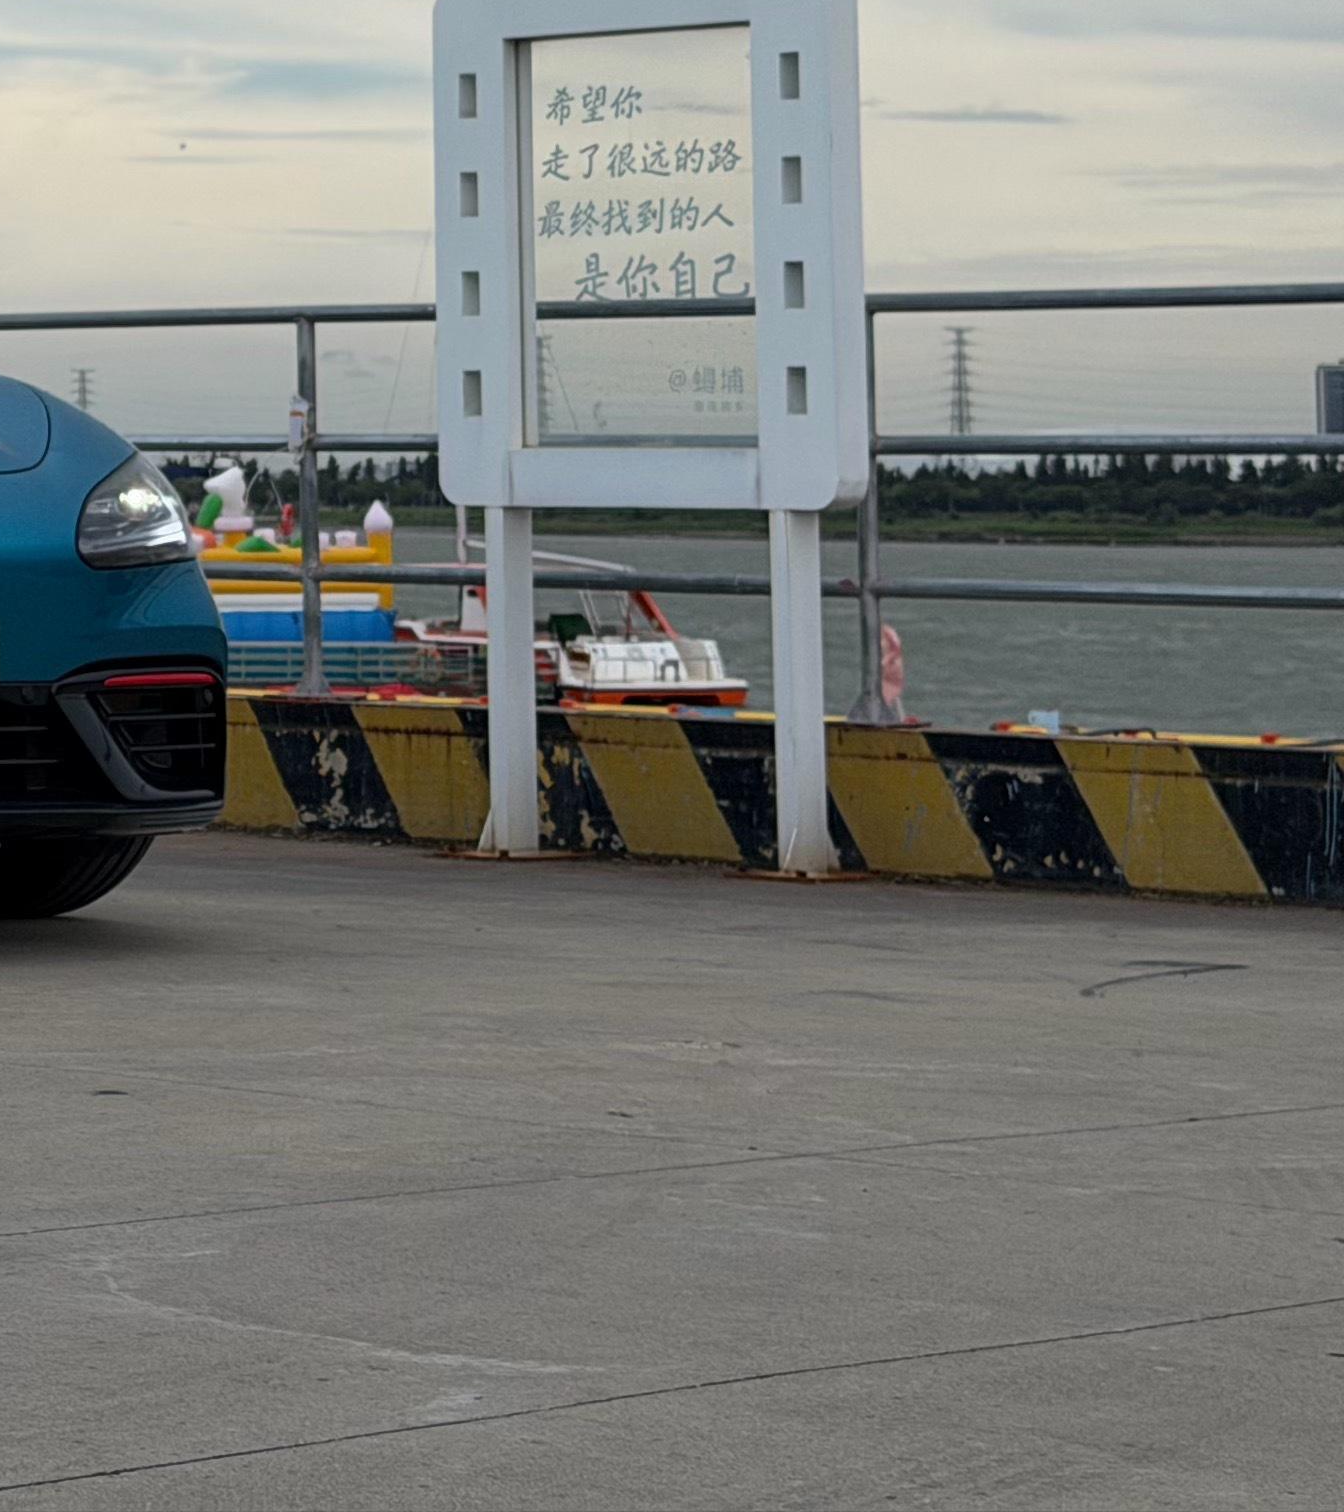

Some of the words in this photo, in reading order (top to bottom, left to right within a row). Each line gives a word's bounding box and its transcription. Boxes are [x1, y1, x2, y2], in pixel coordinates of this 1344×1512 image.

[545, 85, 643, 126] 希望你
[541, 139, 742, 181] 走了很远的路
[537, 196, 735, 239] 最终找到的人
[574, 251, 750, 301] 是你自己
